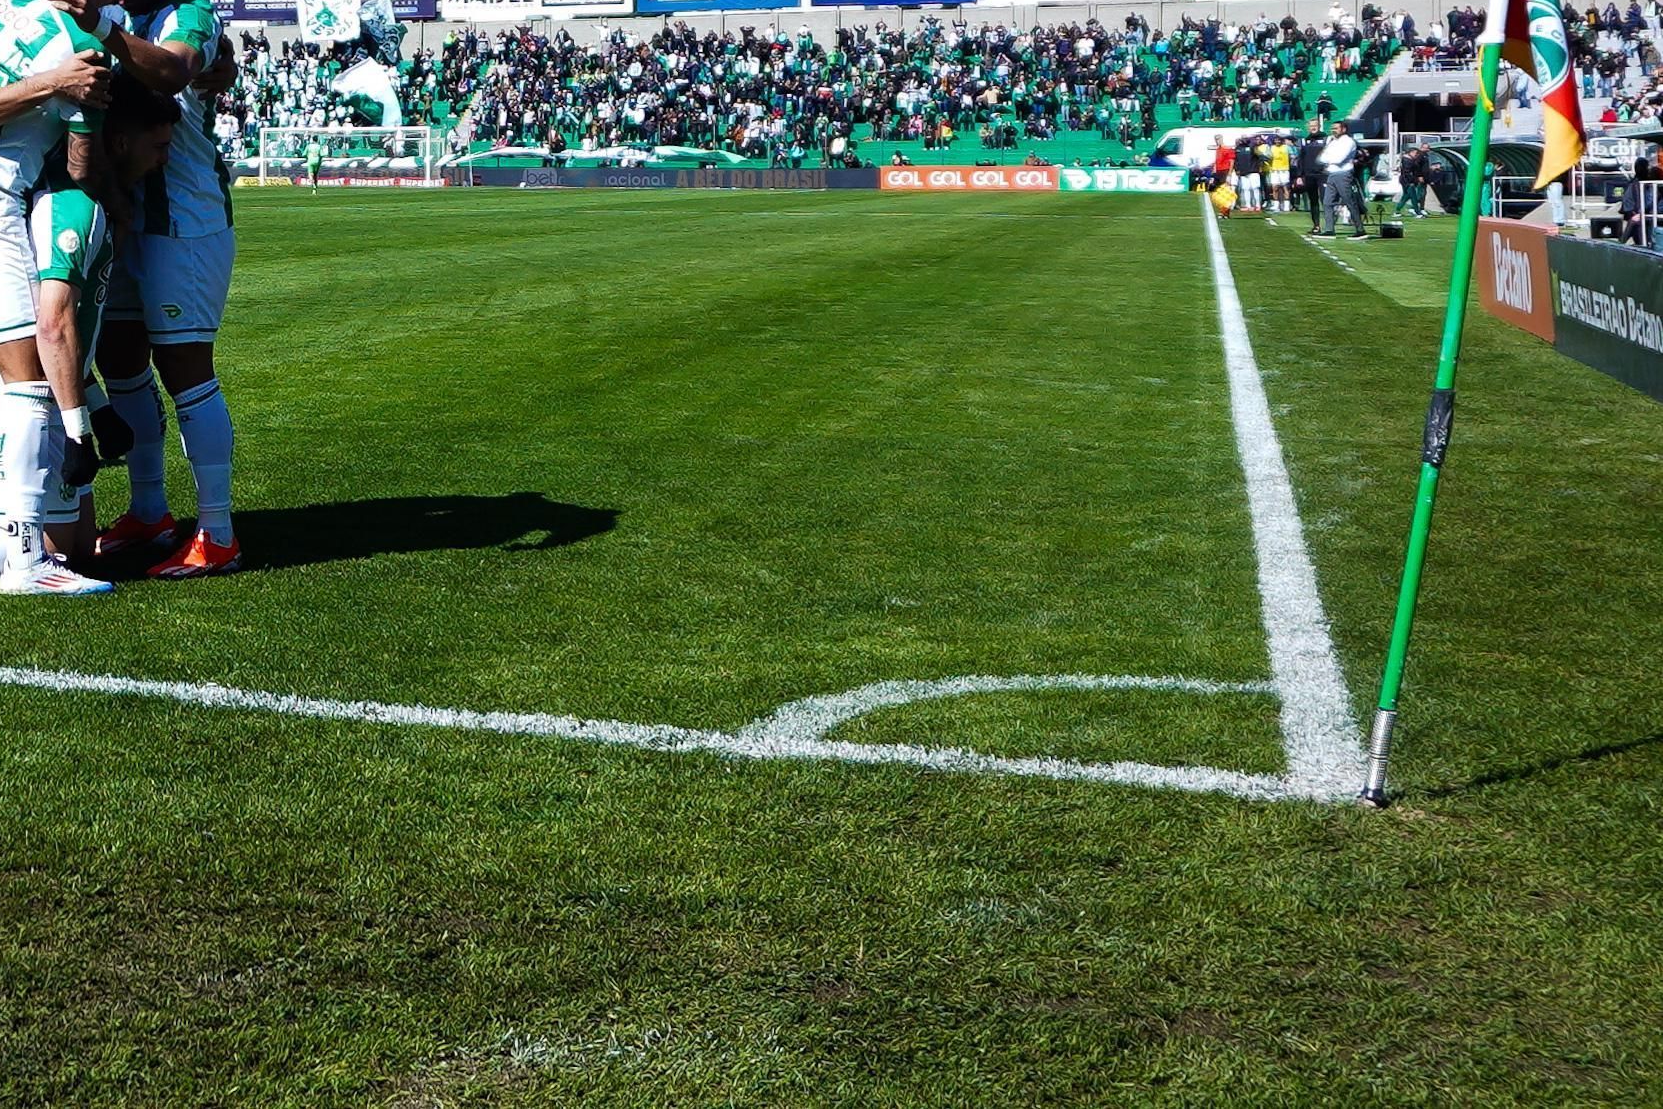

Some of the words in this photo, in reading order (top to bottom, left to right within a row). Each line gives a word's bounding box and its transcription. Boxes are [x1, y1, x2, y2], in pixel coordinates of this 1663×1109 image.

[762, 170, 827, 188] BRASIL
[887, 170, 923, 186] GOL
[929, 170, 966, 186] GOL
[972, 170, 1008, 186] GOL
[1015, 170, 1052, 186] GOL
[1119, 170, 1184, 189] TREZE
[1492, 231, 1532, 314] Betano
[1559, 279, 1626, 338] BRASILEIRÃO
